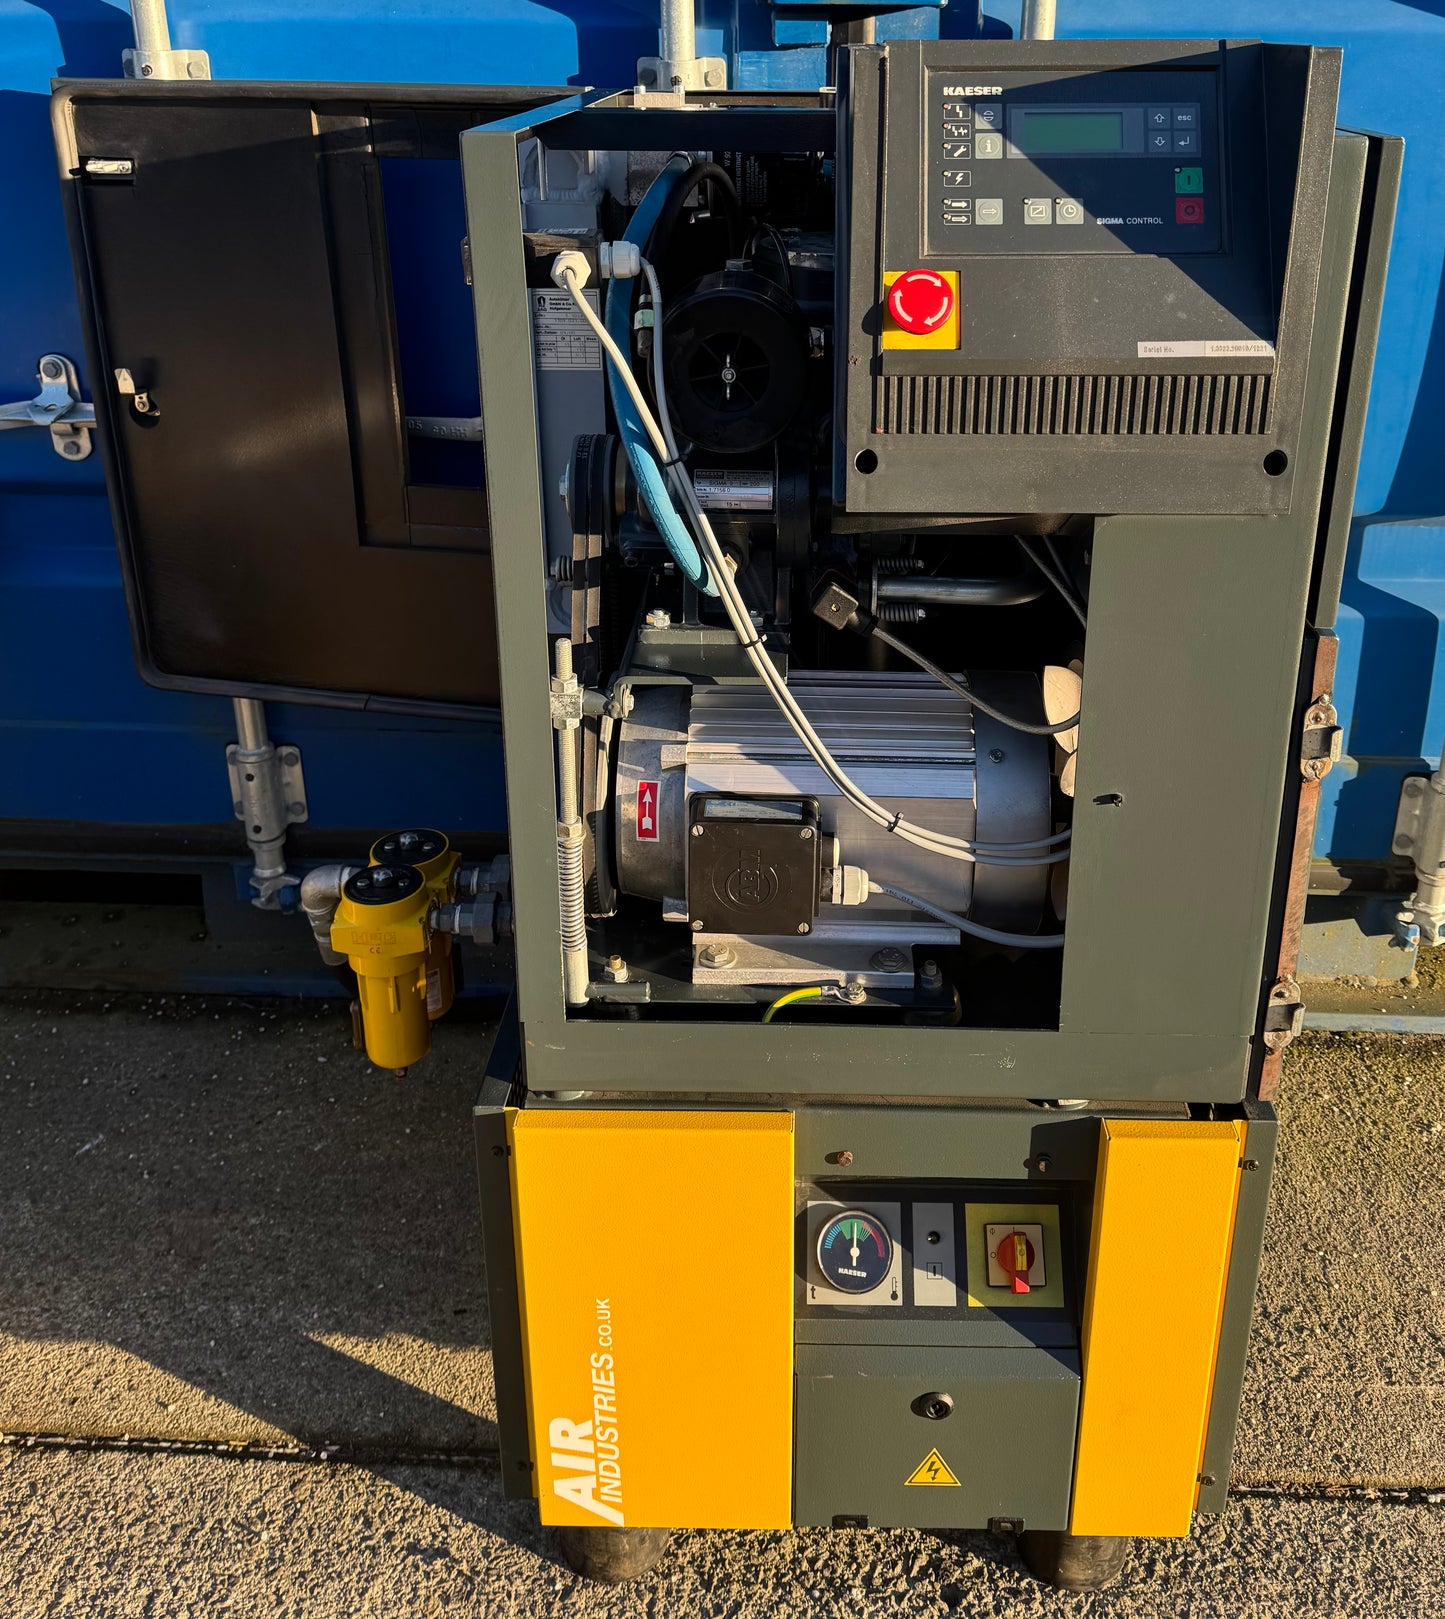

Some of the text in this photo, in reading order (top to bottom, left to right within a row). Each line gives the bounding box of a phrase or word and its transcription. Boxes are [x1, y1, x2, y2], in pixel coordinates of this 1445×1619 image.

[943, 86, 1003, 96] KAESER
[1096, 217, 1164, 225] SIGMA CONTROL
[838, 1267, 867, 1278] KAESER
[548, 1417, 625, 1528] AIR
